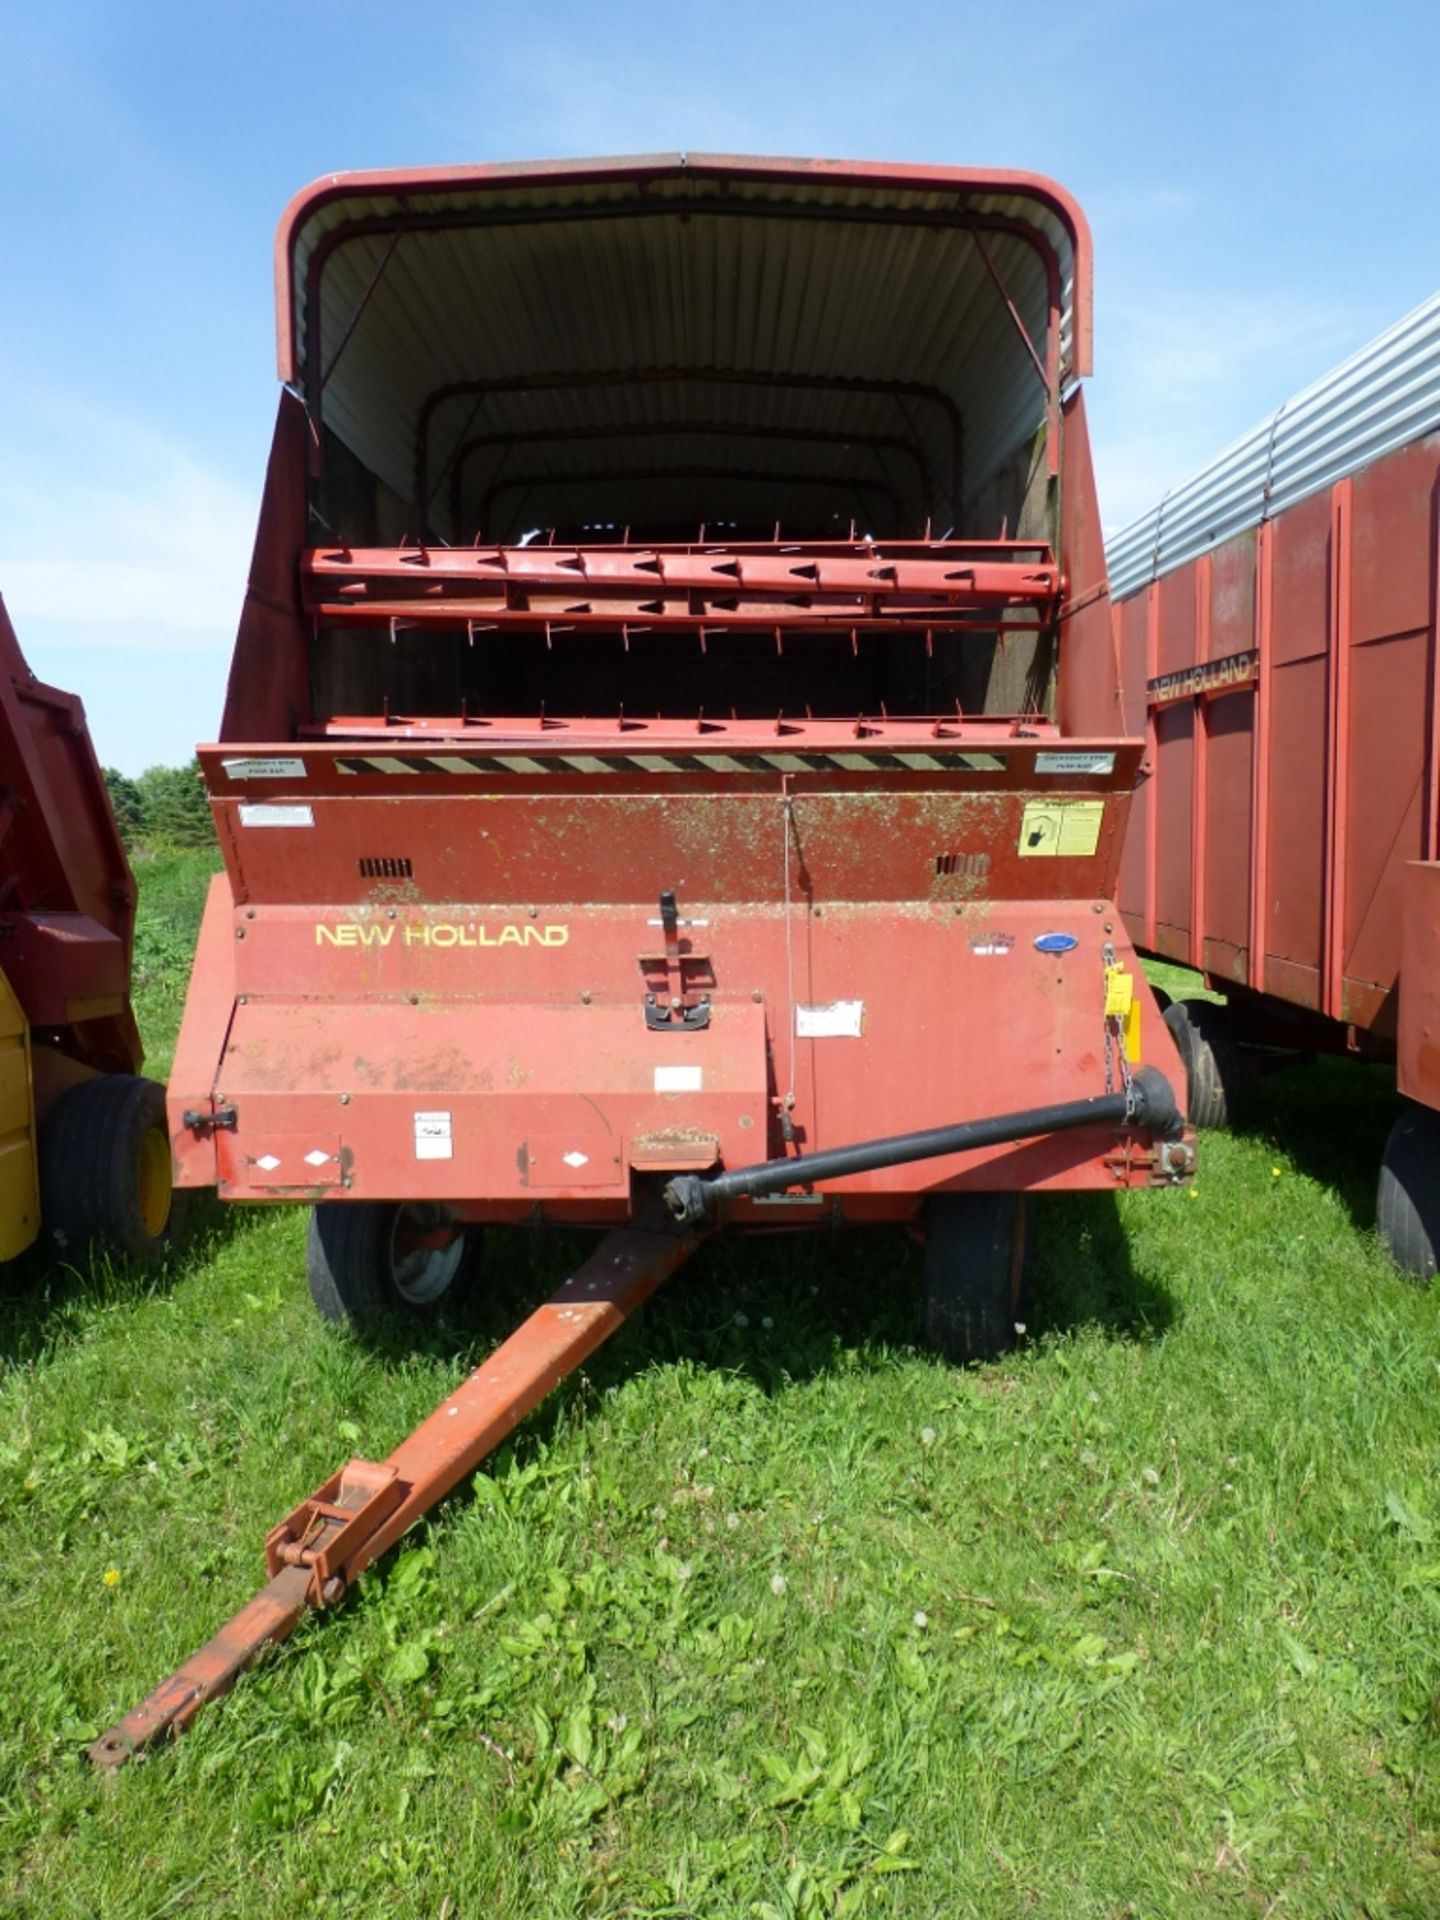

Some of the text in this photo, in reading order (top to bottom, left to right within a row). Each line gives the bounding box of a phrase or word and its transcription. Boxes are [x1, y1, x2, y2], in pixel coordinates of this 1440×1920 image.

[1154, 655, 1250, 701] NEW HOLLAND
[316, 924, 569, 946] NEW HOLLAND
